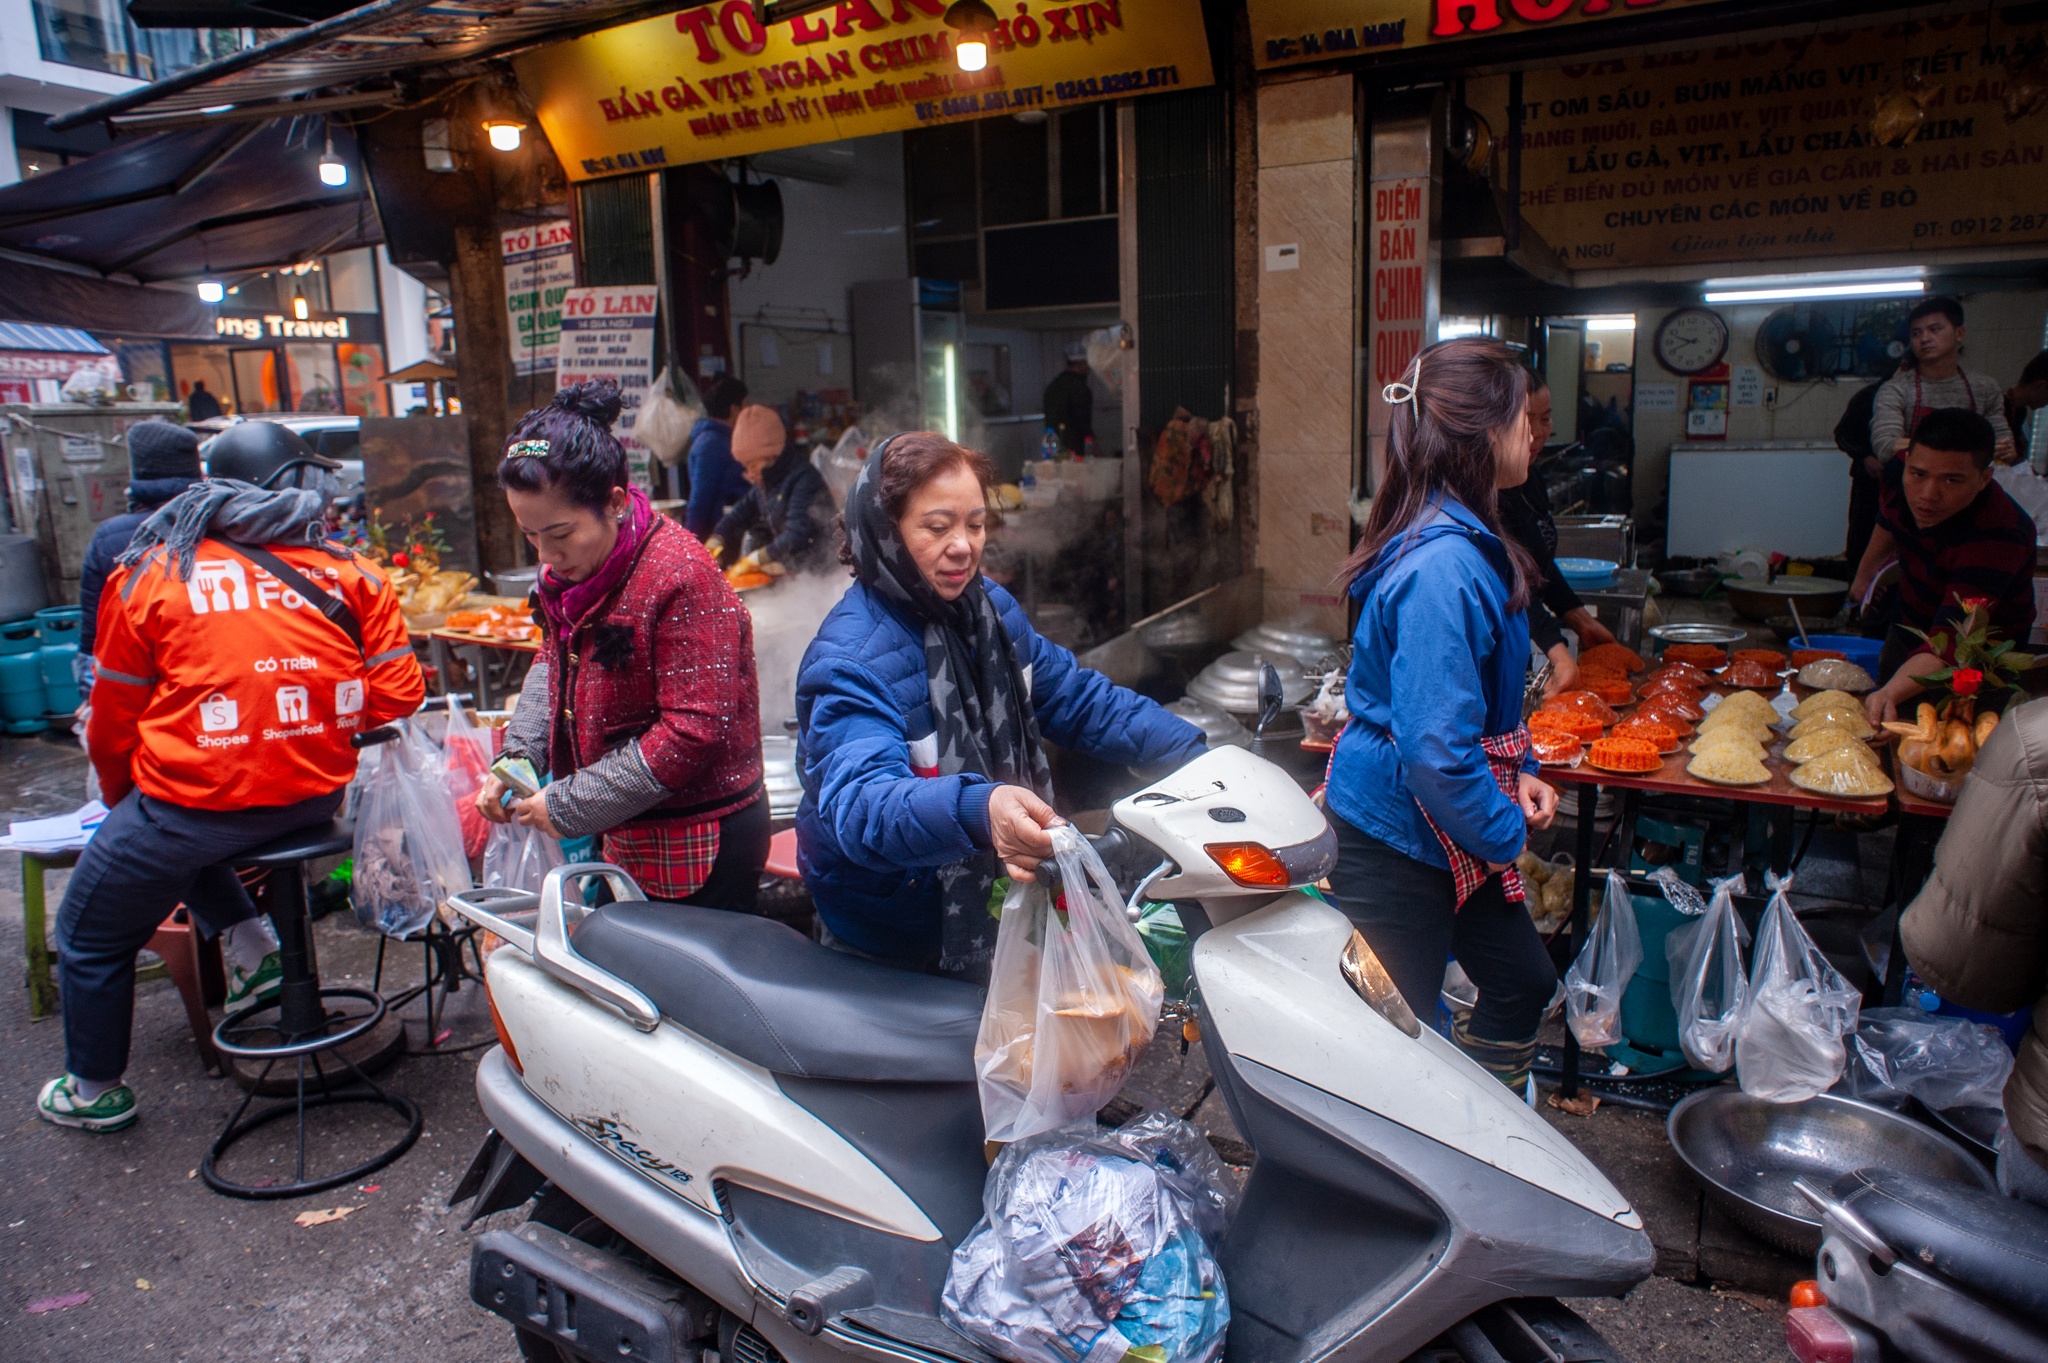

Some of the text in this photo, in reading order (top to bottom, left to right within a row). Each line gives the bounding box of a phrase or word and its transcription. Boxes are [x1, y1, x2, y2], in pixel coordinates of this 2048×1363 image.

[599, 87, 661, 122] BÁN
[661, 77, 705, 111] GÀ
[700, 70, 753, 103] VỊT
[758, 51, 856, 93] NGAN
[859, 31, 948, 71] CHIM
[1043, 0, 1121, 42] XỊN
[1550, 97, 1589, 116] OM
[1674, 78, 1731, 104] BÚN
[1649, 114, 1679, 138] GÀ
[1758, 104, 1793, 128] VỊT
[1803, 124, 1872, 152] CHÁ
[1914, 117, 1975, 142] HIM
[1564, 178, 1615, 203] BIẾN
[1621, 173, 1656, 198] ĐỦ
[1663, 172, 1720, 195] MÓN
[1768, 166, 1812, 187] GIA
[1892, 158, 1912, 176] &
[1922, 145, 1971, 173] HẢI
[1980, 140, 2044, 168] SẢN
[1605, 203, 1701, 228] CHUYÊN
[1709, 198, 1760, 221] CÁC
[1769, 194, 1829, 217] MÓN
[1880, 185, 1919, 209] BÒ
[536, 227, 573, 247] LAN
[1950, 217, 2002, 235] 0912
[1379, 223, 1416, 261] BÁN
[603, 295, 656, 315] LAN
[1376, 266, 1422, 321] CHIM
[264, 315, 349, 338] Travel
[254, 655, 318, 673] CÓ TRÊN
[196, 734, 249, 749] Shopee
[262, 724, 325, 741] ShopeeFood
[670, 1168, 694, 1183] 125
